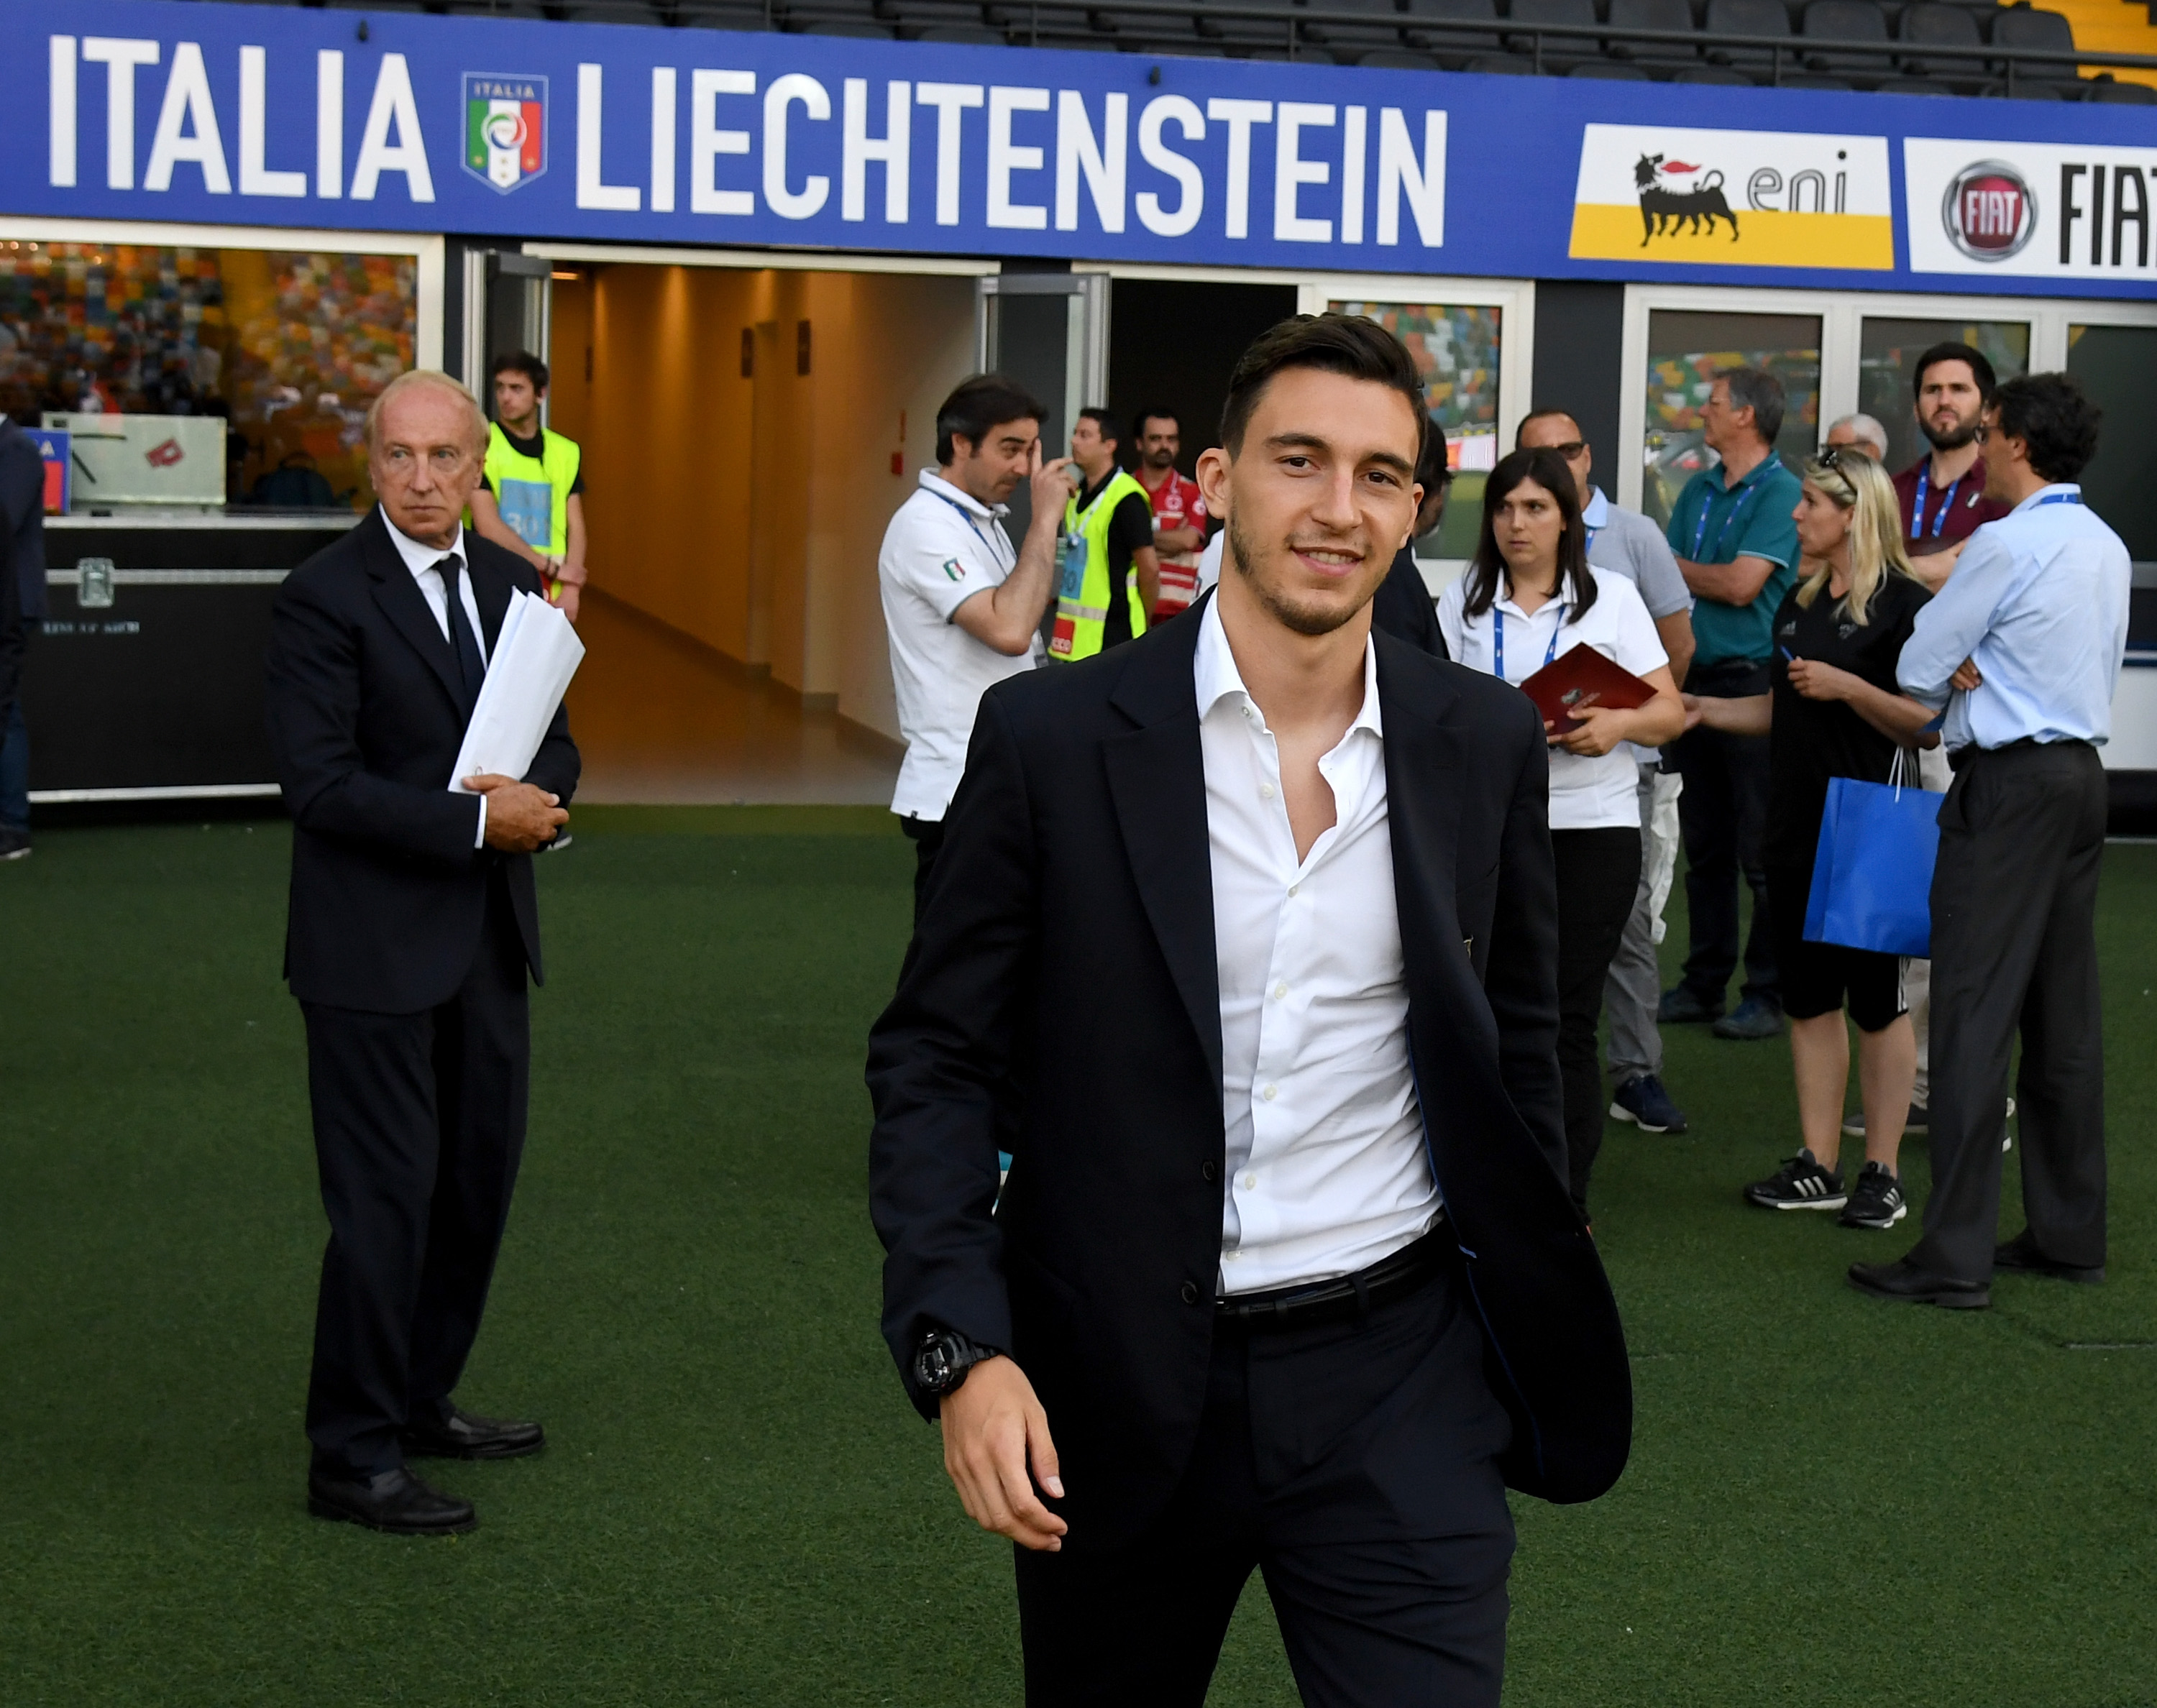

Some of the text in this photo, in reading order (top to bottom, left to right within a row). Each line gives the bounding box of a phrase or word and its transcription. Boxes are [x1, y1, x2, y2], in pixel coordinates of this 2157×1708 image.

[473, 81, 535, 98] ITALIA
[50, 35, 1447, 248] ITALIA LIECHTENSTEIN
[1746, 150, 1847, 215] eni
[1966, 190, 2020, 236] FIAT
